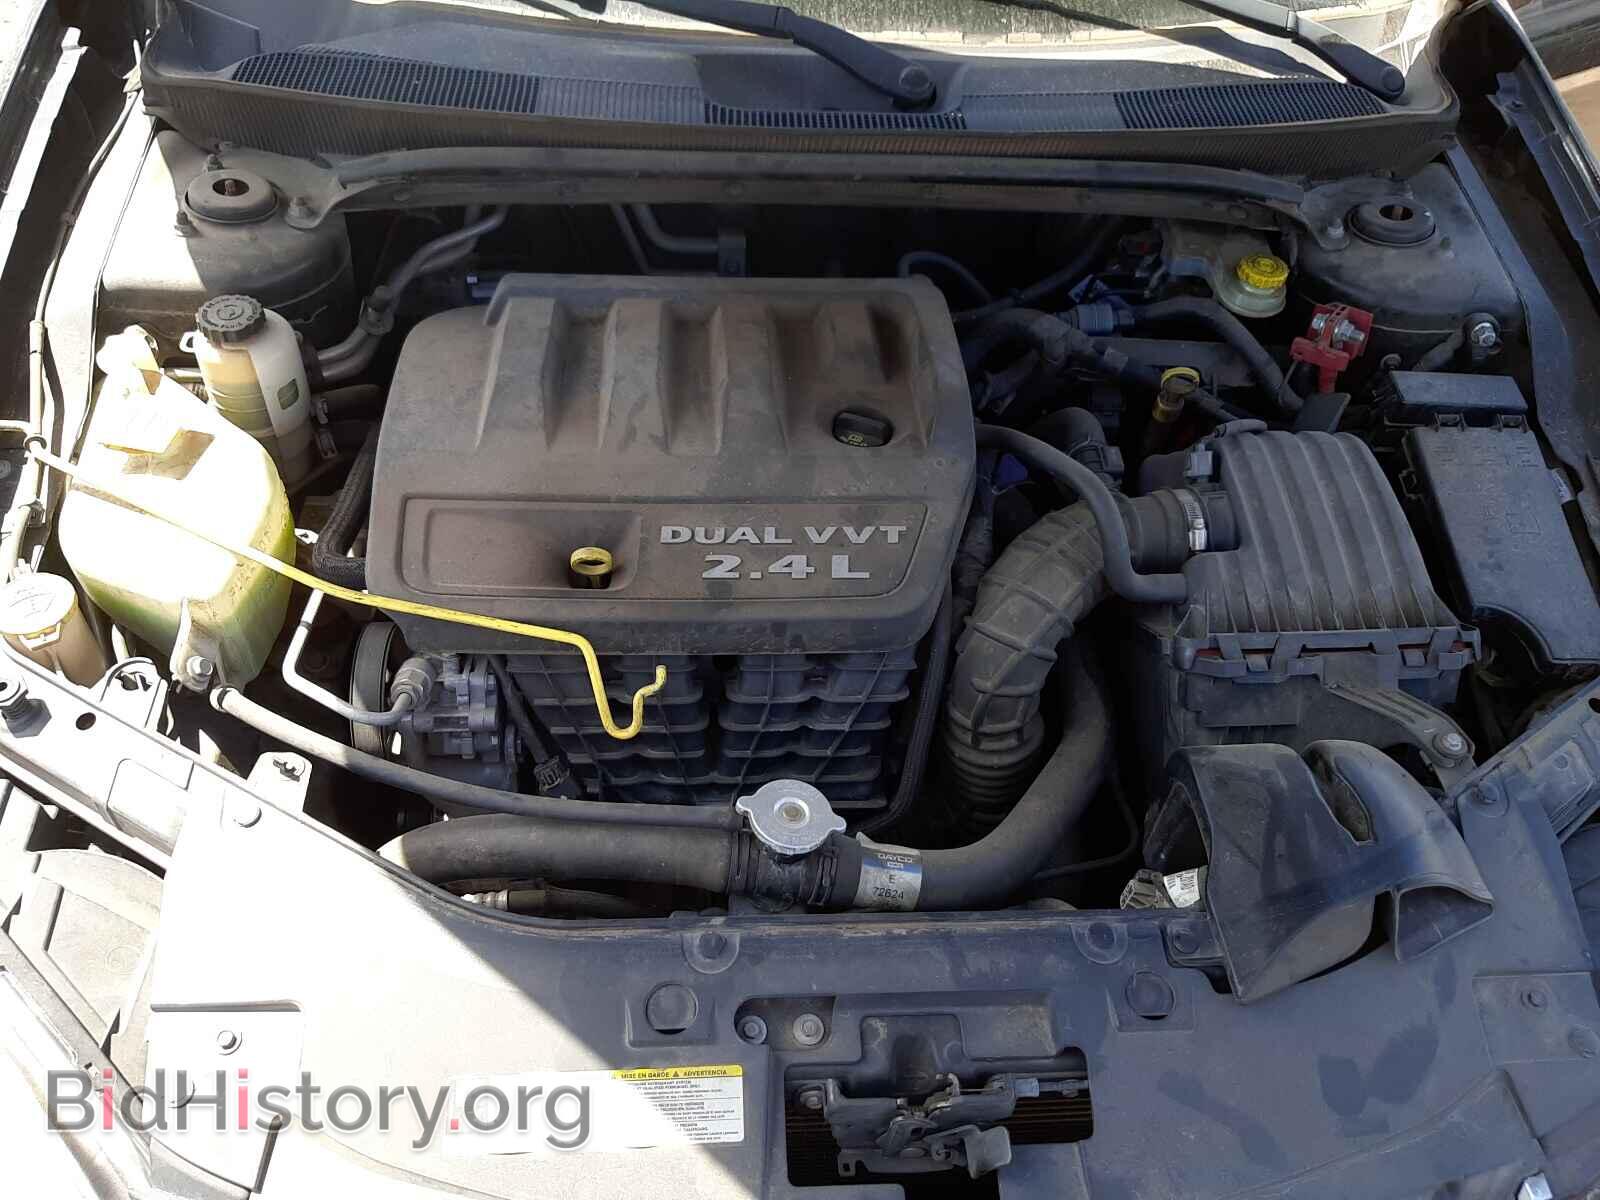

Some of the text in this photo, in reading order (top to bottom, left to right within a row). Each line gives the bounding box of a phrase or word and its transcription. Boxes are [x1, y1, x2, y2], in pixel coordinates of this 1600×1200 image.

[660, 525, 907, 544] DUAL VVT
[889, 874, 896, 884] E
[683, 1069, 728, 1077] ADVERTENCIA
